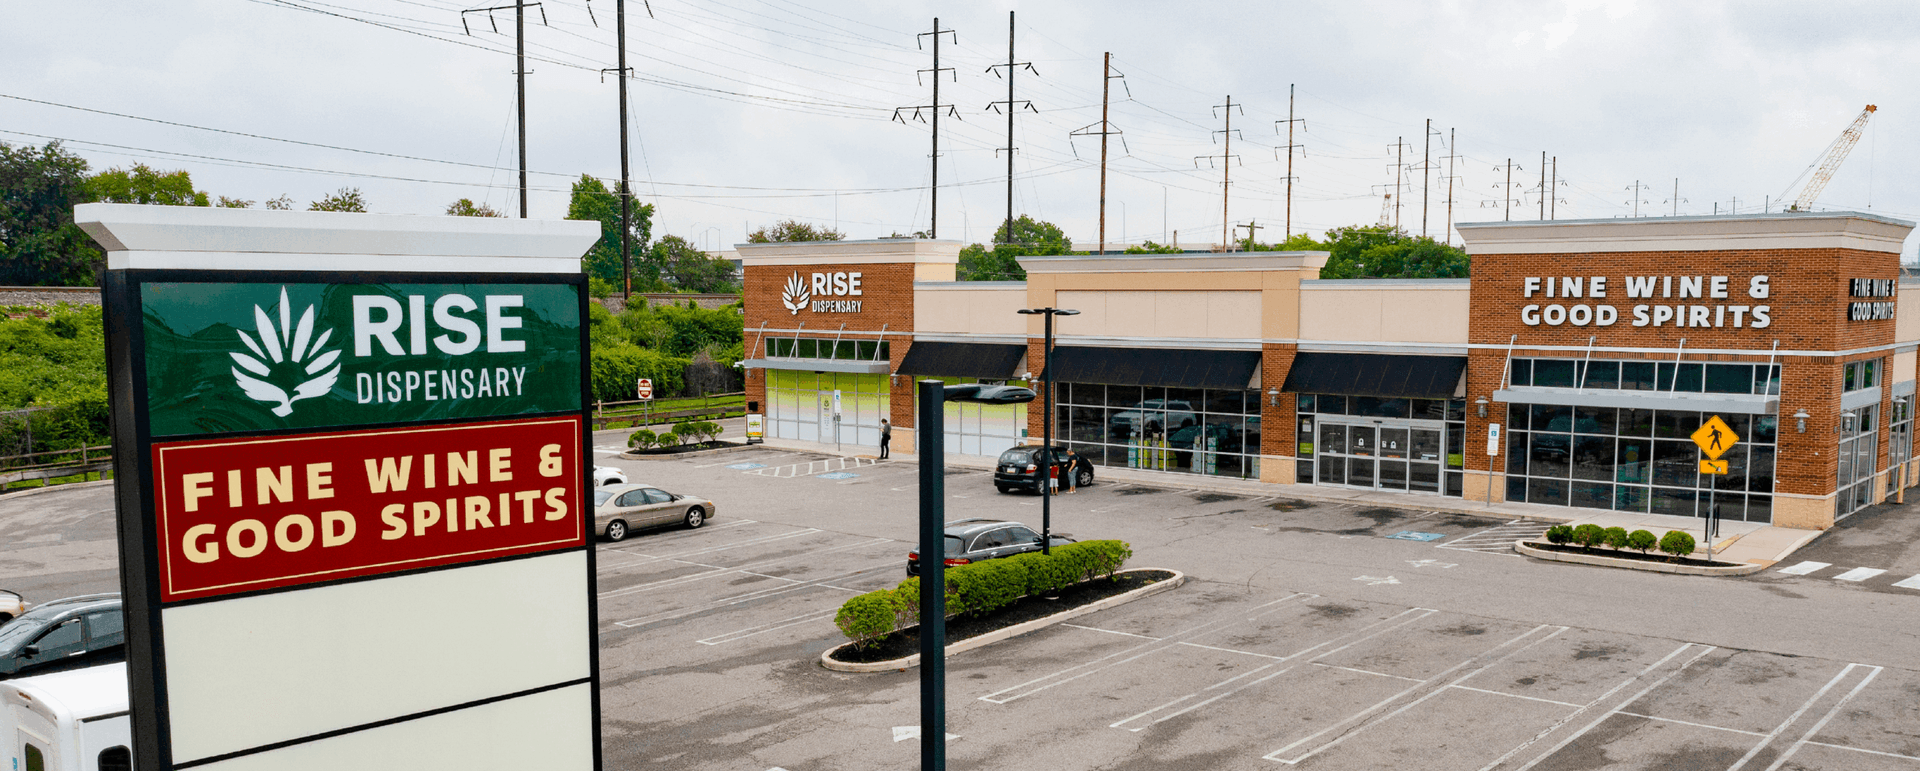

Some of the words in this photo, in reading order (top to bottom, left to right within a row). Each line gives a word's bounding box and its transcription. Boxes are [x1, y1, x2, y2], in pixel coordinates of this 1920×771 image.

[812, 272, 862, 296] RISE
[1524, 276, 1607, 298] FINE
[1625, 276, 1729, 298] WINE
[1749, 275, 1769, 298] &
[1853, 278, 1871, 297] FINE
[1872, 279, 1890, 297] WINE
[812, 300, 862, 313] DISPENSARY
[1521, 304, 1618, 326] GOOD
[1632, 304, 1771, 328] SPIRITS
[1852, 302, 1871, 321] GOOD
[352, 293, 526, 357] RISE
[356, 366, 526, 404] DISPENSARY
[182, 462, 335, 512] FINE
[364, 448, 514, 494] WINE
[538, 443, 563, 478] &
[182, 510, 357, 564] GOOD
[381, 487, 568, 540] SPIRITS
